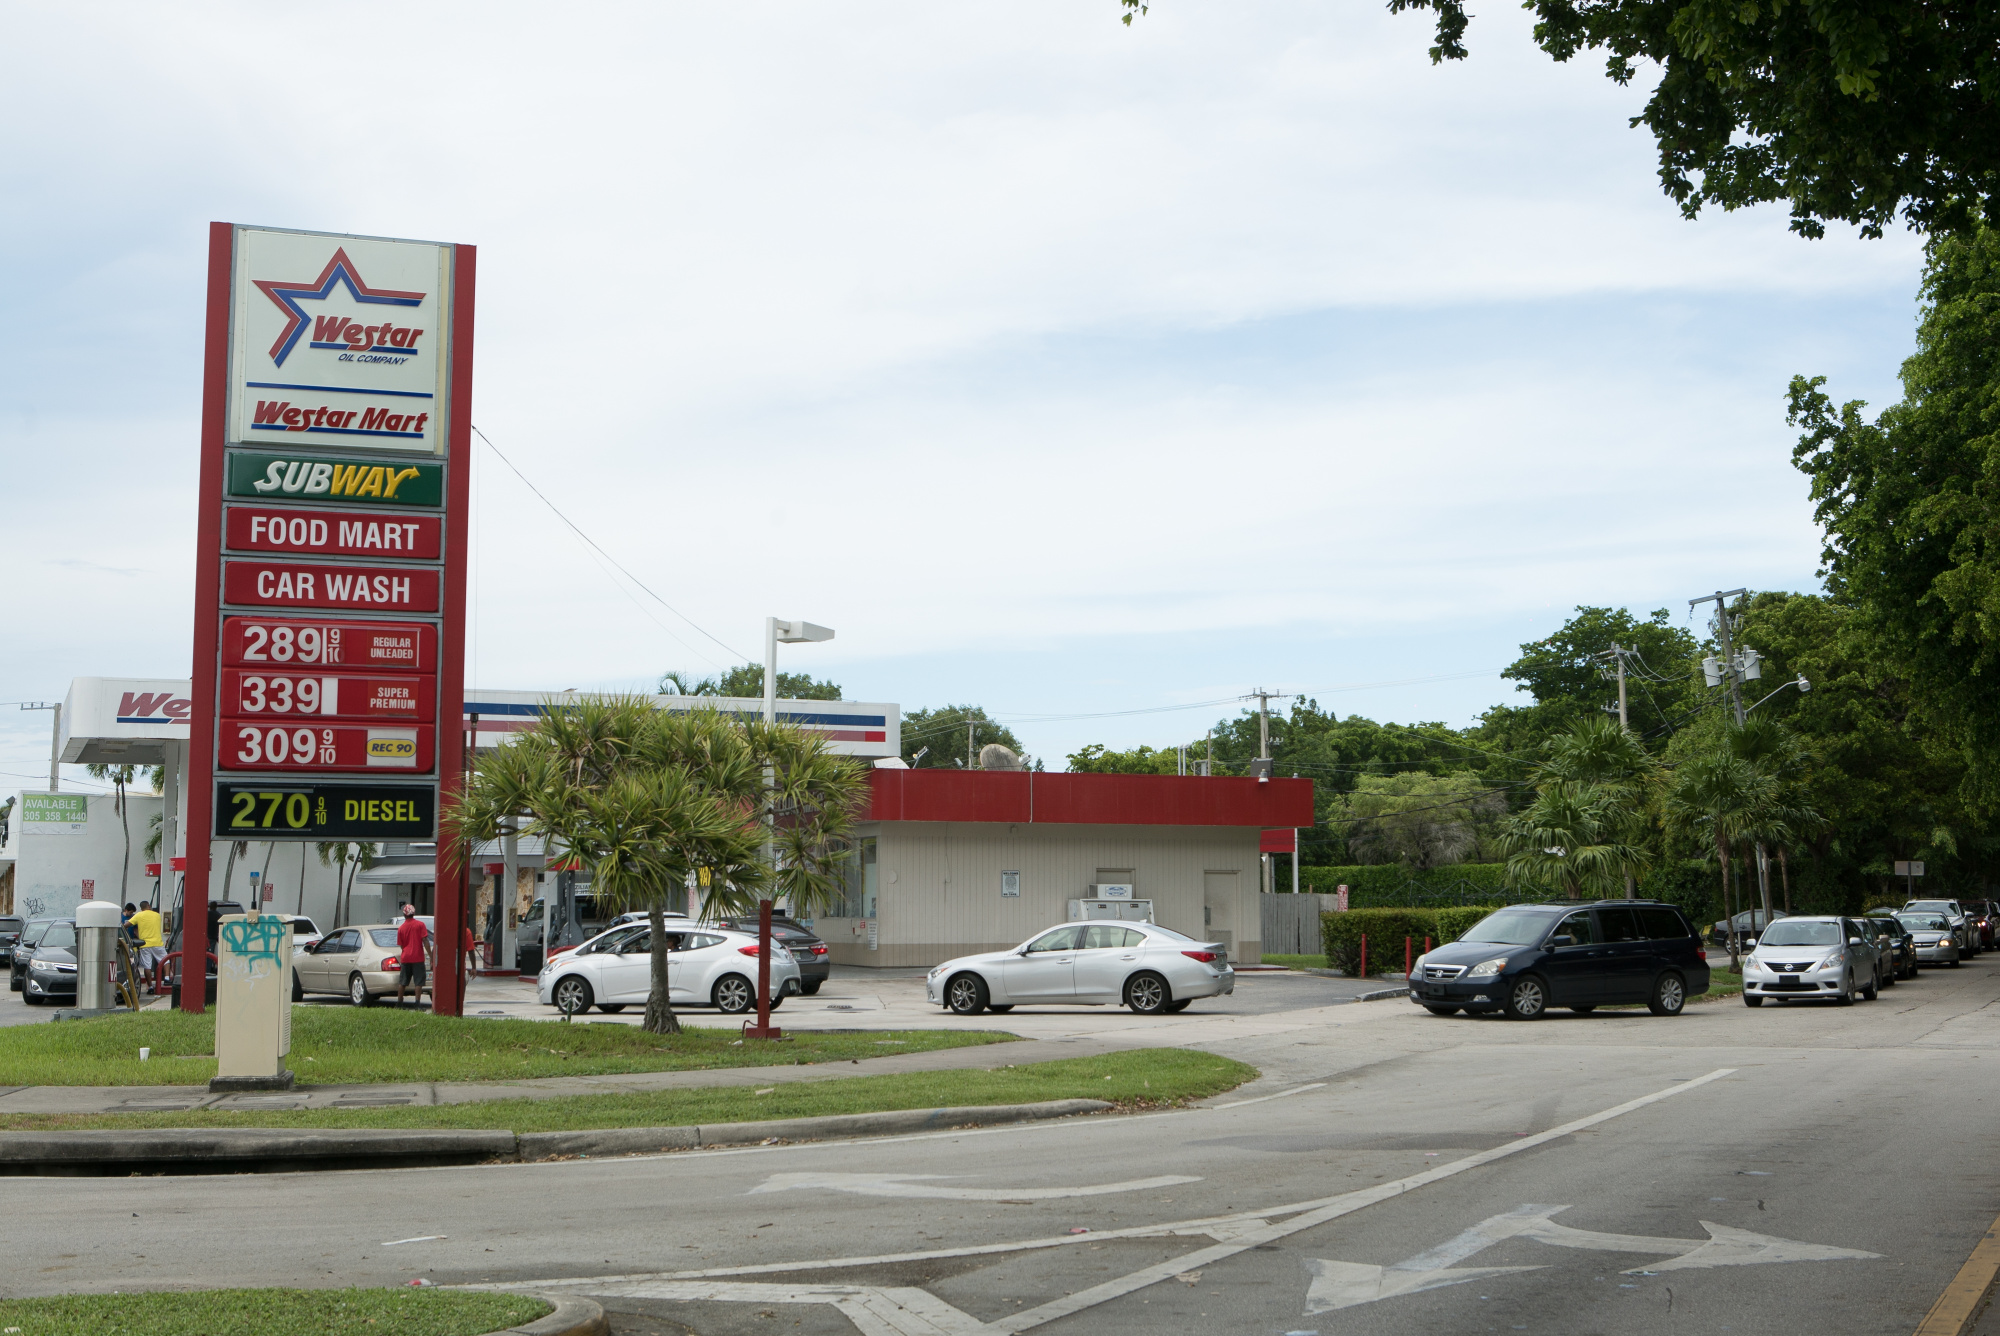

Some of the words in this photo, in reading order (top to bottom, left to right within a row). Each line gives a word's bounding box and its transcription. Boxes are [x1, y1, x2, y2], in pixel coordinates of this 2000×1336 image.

[312, 315, 424, 351] Westar
[338, 353, 355, 362] OIL
[357, 354, 409, 366] COMPANY
[253, 400, 358, 432] Westar
[358, 407, 429, 433] Mart
[253, 460, 420, 498] SUBWAY
[250, 516, 328, 546] FOOD
[338, 520, 420, 550] MART
[257, 570, 315, 600] CAR
[325, 573, 410, 604] WASH
[243, 625, 321, 663] 289
[370, 648, 413, 659] UNLEADED
[373, 636, 411, 648] REGULAR
[117, 691, 191, 724] We
[242, 676, 320, 714] 339
[377, 687, 409, 699] SUPER
[370, 698, 416, 710] PREMIUM
[237, 727, 316, 764] 309
[371, 743, 393, 753] REC
[396, 743, 412, 753] 90
[24, 799, 77, 809] AVAILABLE
[24, 811, 40, 821] 305
[45, 811, 61, 821] 358
[66, 812, 86, 821] 1440
[231, 791, 310, 829] 270
[344, 799, 420, 822] DIESEL
